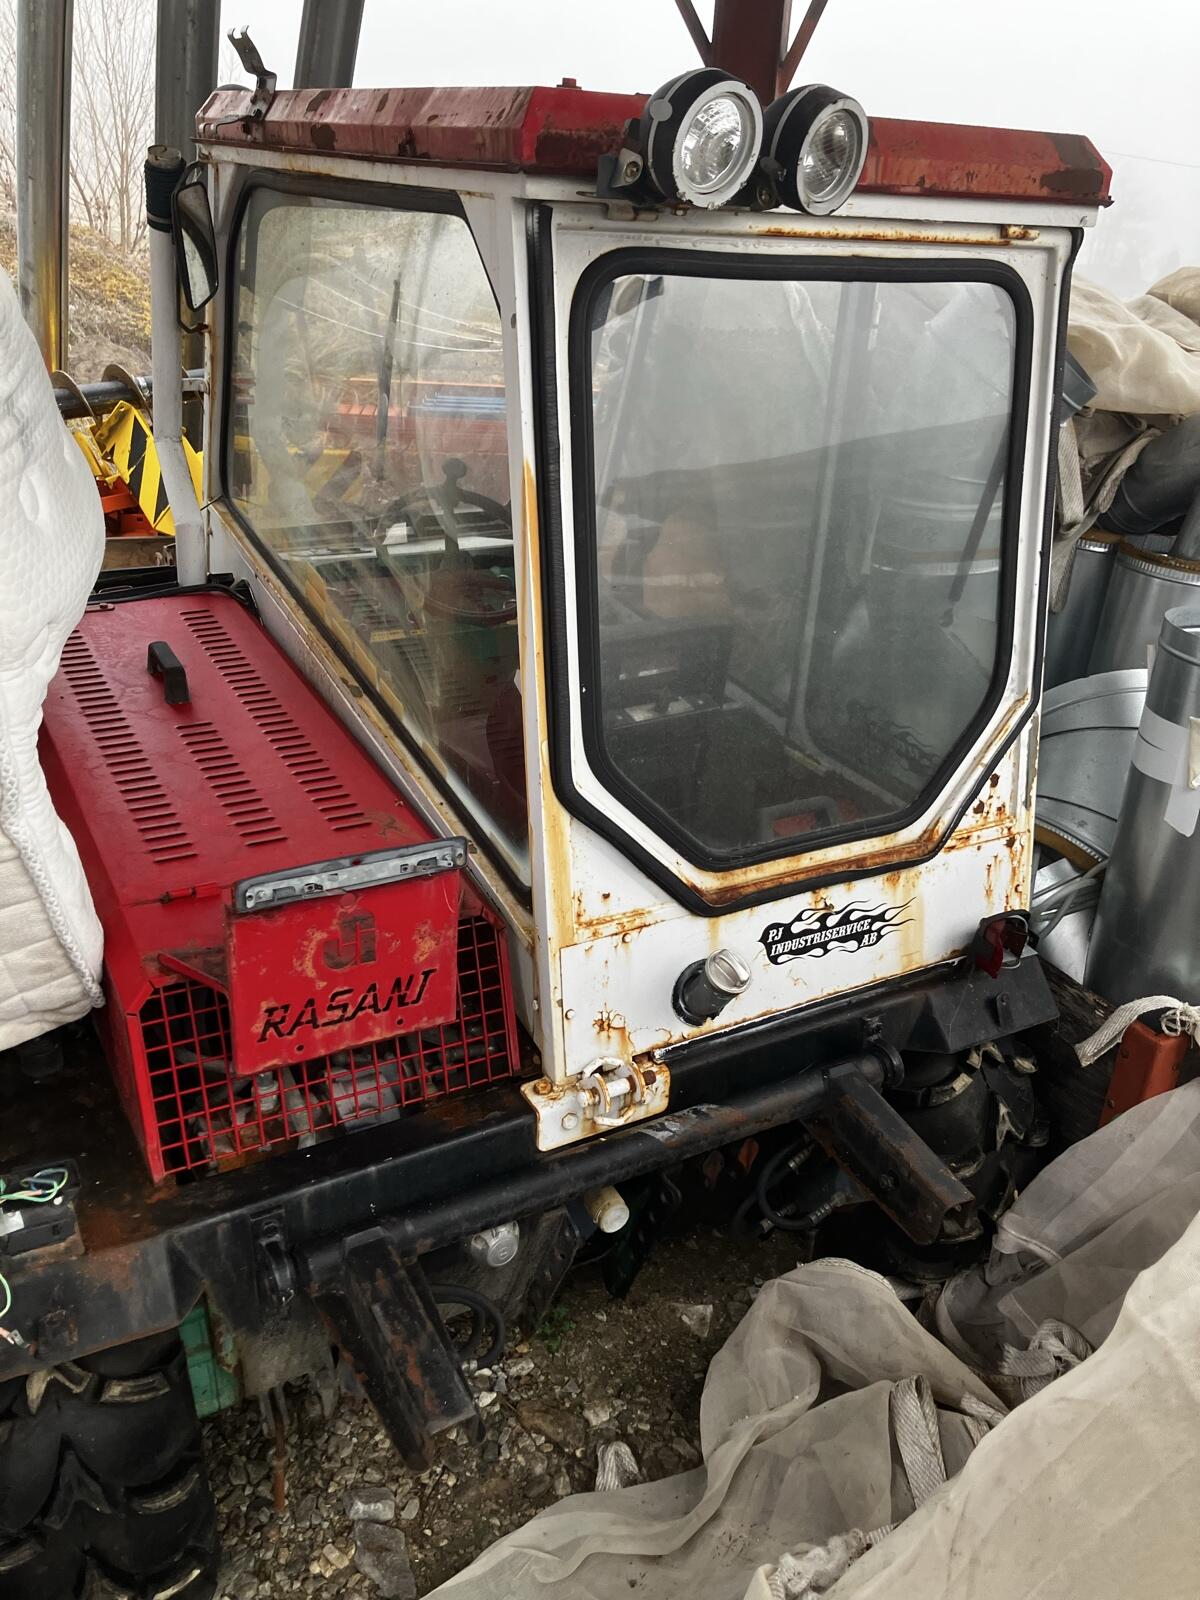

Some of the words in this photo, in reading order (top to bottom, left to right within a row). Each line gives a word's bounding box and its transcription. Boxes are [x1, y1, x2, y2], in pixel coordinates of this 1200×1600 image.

[767, 926, 784, 943] PJ
[769, 919, 872, 956] INDUSTRISERVICE
[860, 931, 878, 947] AB
[256, 968, 437, 1043] RASANT
